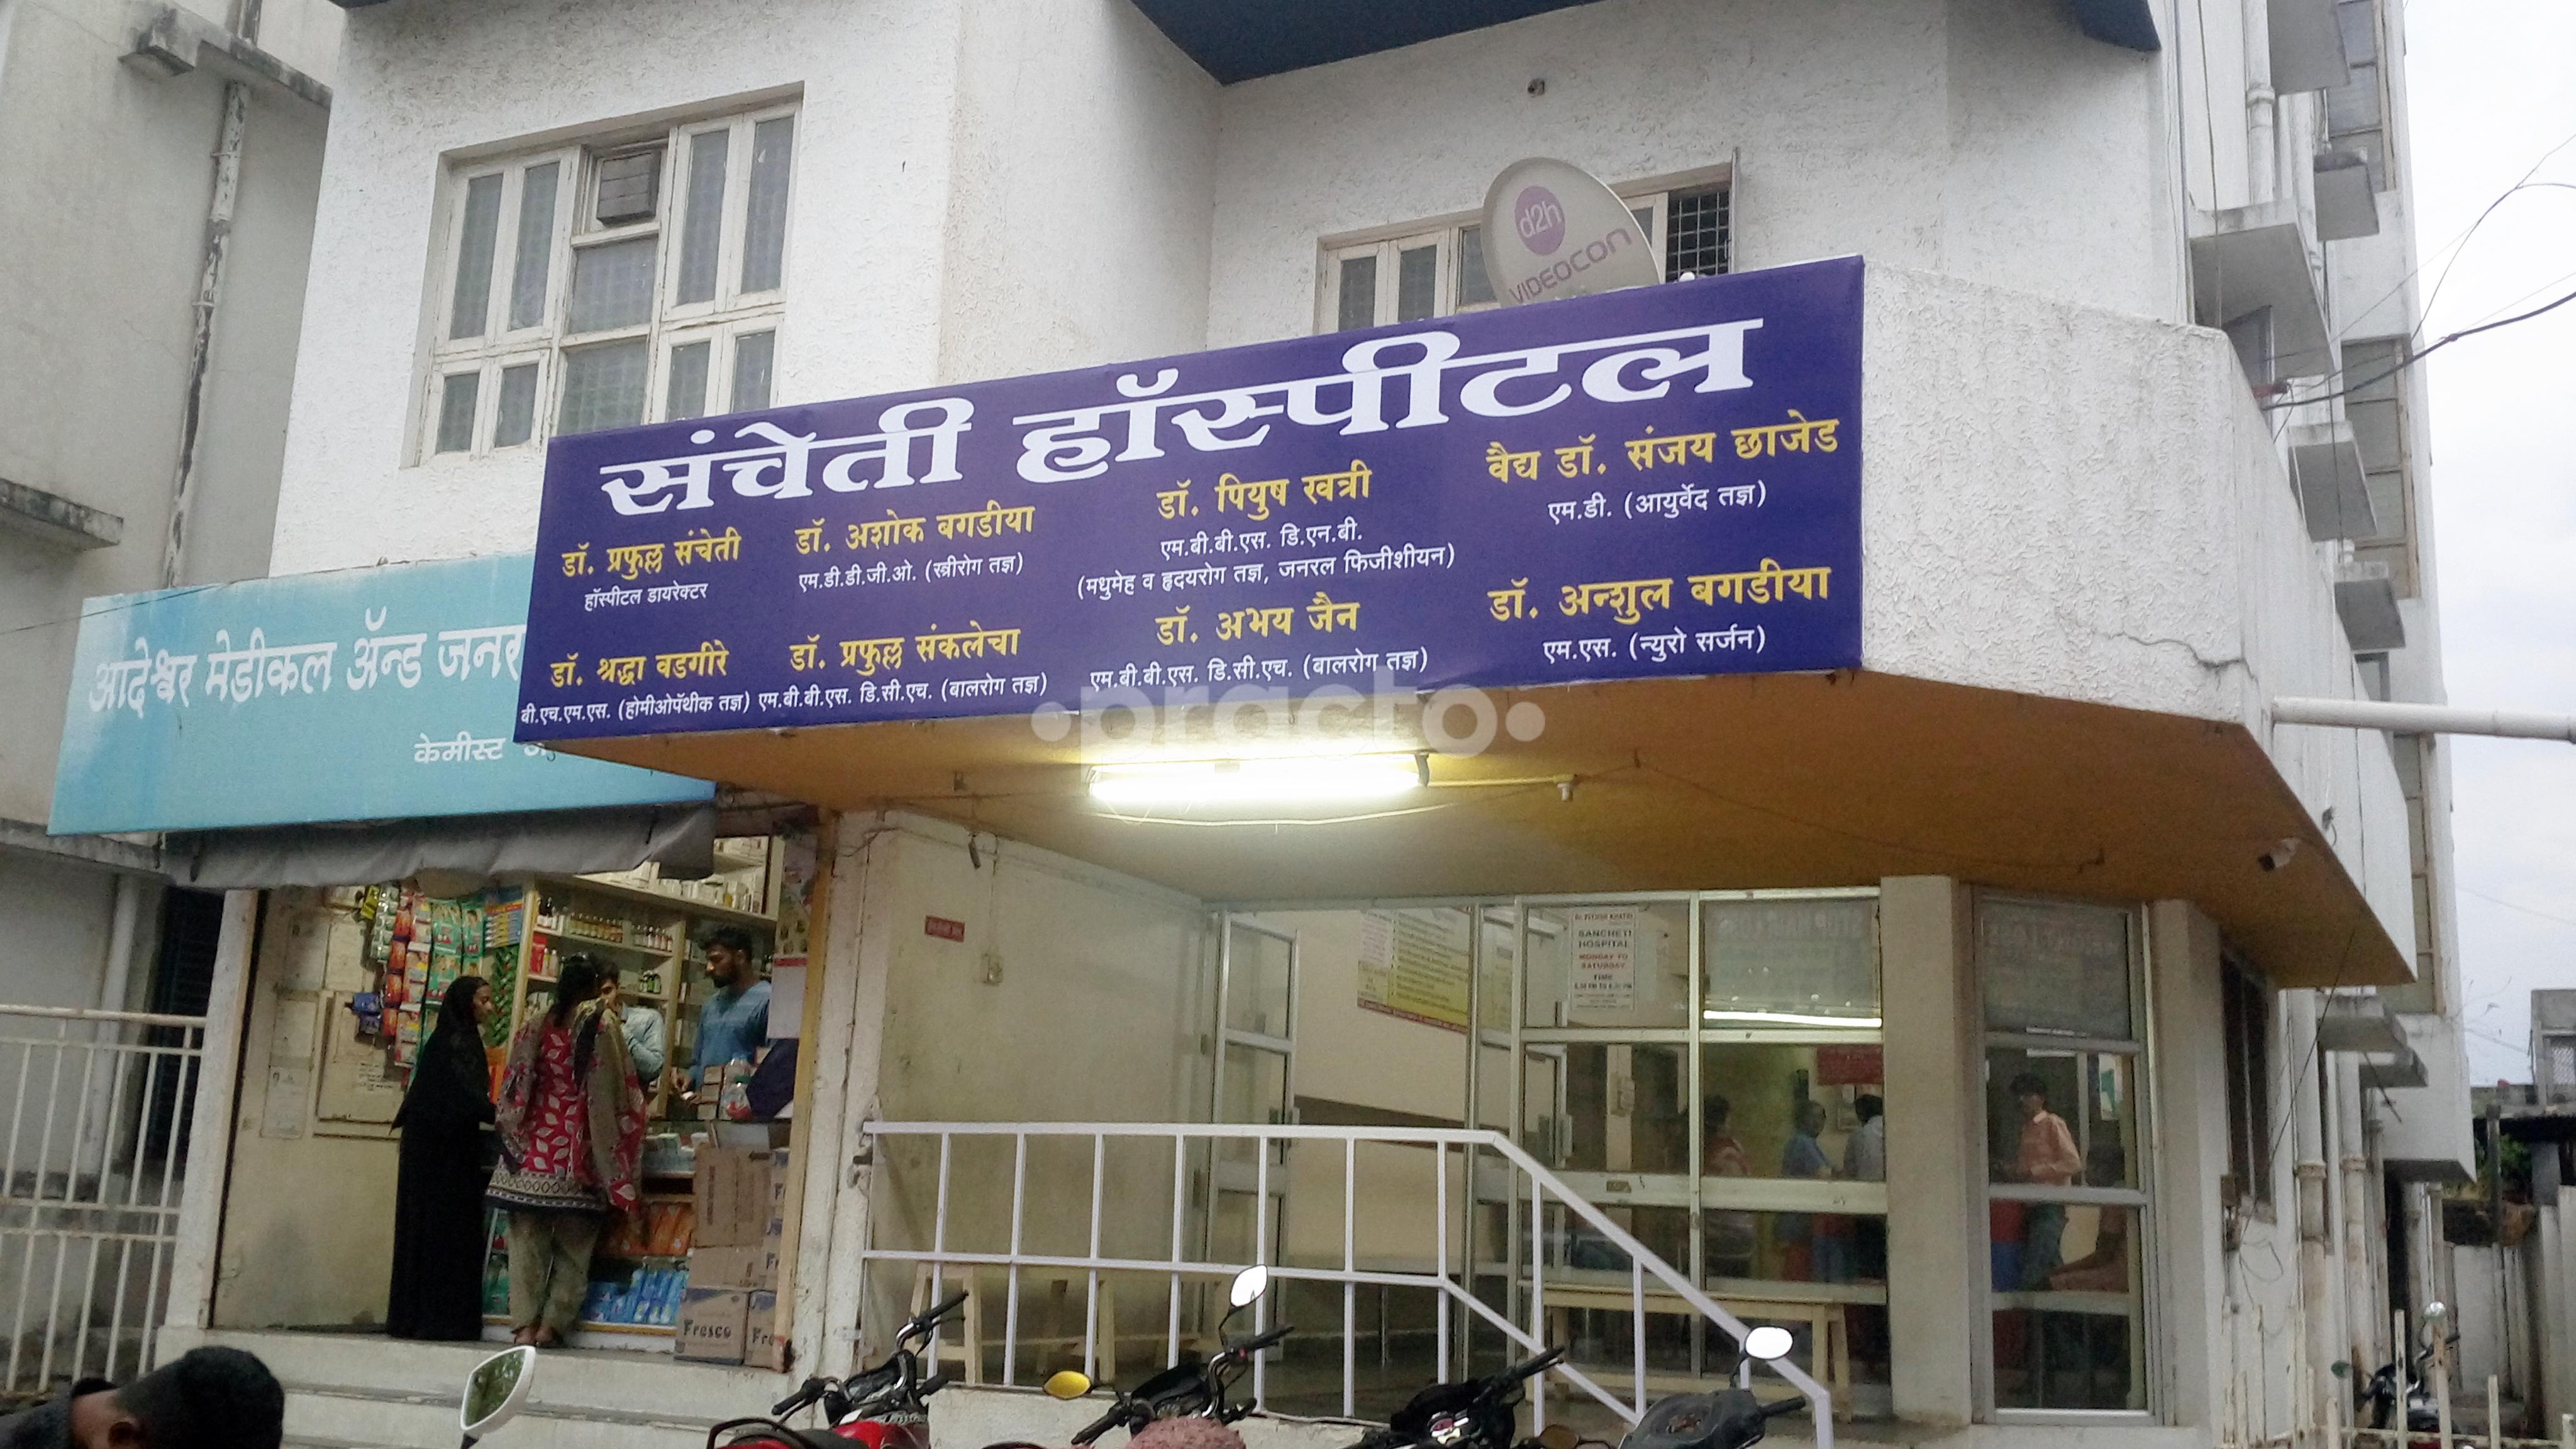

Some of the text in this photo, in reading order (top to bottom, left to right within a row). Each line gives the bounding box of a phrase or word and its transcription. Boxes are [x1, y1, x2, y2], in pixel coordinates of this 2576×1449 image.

[1519, 199, 1563, 240] d2h
[599, 318, 1764, 516] संचेती हॉस्पीटल
[1487, 410, 1839, 482] वैद्य डॉ. संजय छाजेड
[1157, 460, 1372, 521] डॉ. पियुष खत्री
[1548, 480, 1765, 525] एम.डी. (आयुर्वेद तज्ञ)
[795, 500, 1035, 553] डॉ. अशोक बगडीया
[1161, 516, 1362, 561] एम.बी.बी.एस. डि.एन.बी.
[563, 527, 741, 580] डॉ. प्रफुल्ल संचेती
[926, 553, 983, 583] (स्त्रीरोग
[989, 552, 1023, 575] तज्ञ)
[1078, 570, 1136, 601] (मधुमेह
[1142, 574, 1155, 590] व
[1233, 564, 1269, 584] तज्ञ,
[1279, 557, 1336, 578] जनरल
[1343, 543, 1454, 574] फिजीशीयन)
[585, 580, 708, 611] हॉस्पीटल डायरेक्टर
[1489, 558, 1831, 625] डॉ. अन्शुल बगडीया
[1157, 592, 1360, 645] डॉ. अभय जैन
[551, 640, 729, 687] डॉ. श्रद्धा वडगीरे
[791, 621, 1021, 676] डॉ. प्रफुल्ल संकलेचा
[1543, 624, 1765, 663] एम.एस. (न्युरो सर्जन)
[89, 637, 197, 719] आदेश्वर
[205, 628, 338, 703] मेडीकल
[438, 624, 527, 682] जनर
[759, 672, 1046, 711] एम.बी.बी.एस. डि.सी.एच. (बालरोग तज्ञ)
[1090, 646, 1428, 692] एम.बी.बी.एस. डि.सी.एच. (बालरोग तज्ञ)
[521, 703, 610, 724] बी.एच.एम.एस.
[719, 691, 750, 713] तज्ञ)
[414, 731, 506, 764] केमीस्ट
[1579, 940, 1628, 948] HOSPITAL
[684, 1320, 731, 1339] Fresco
